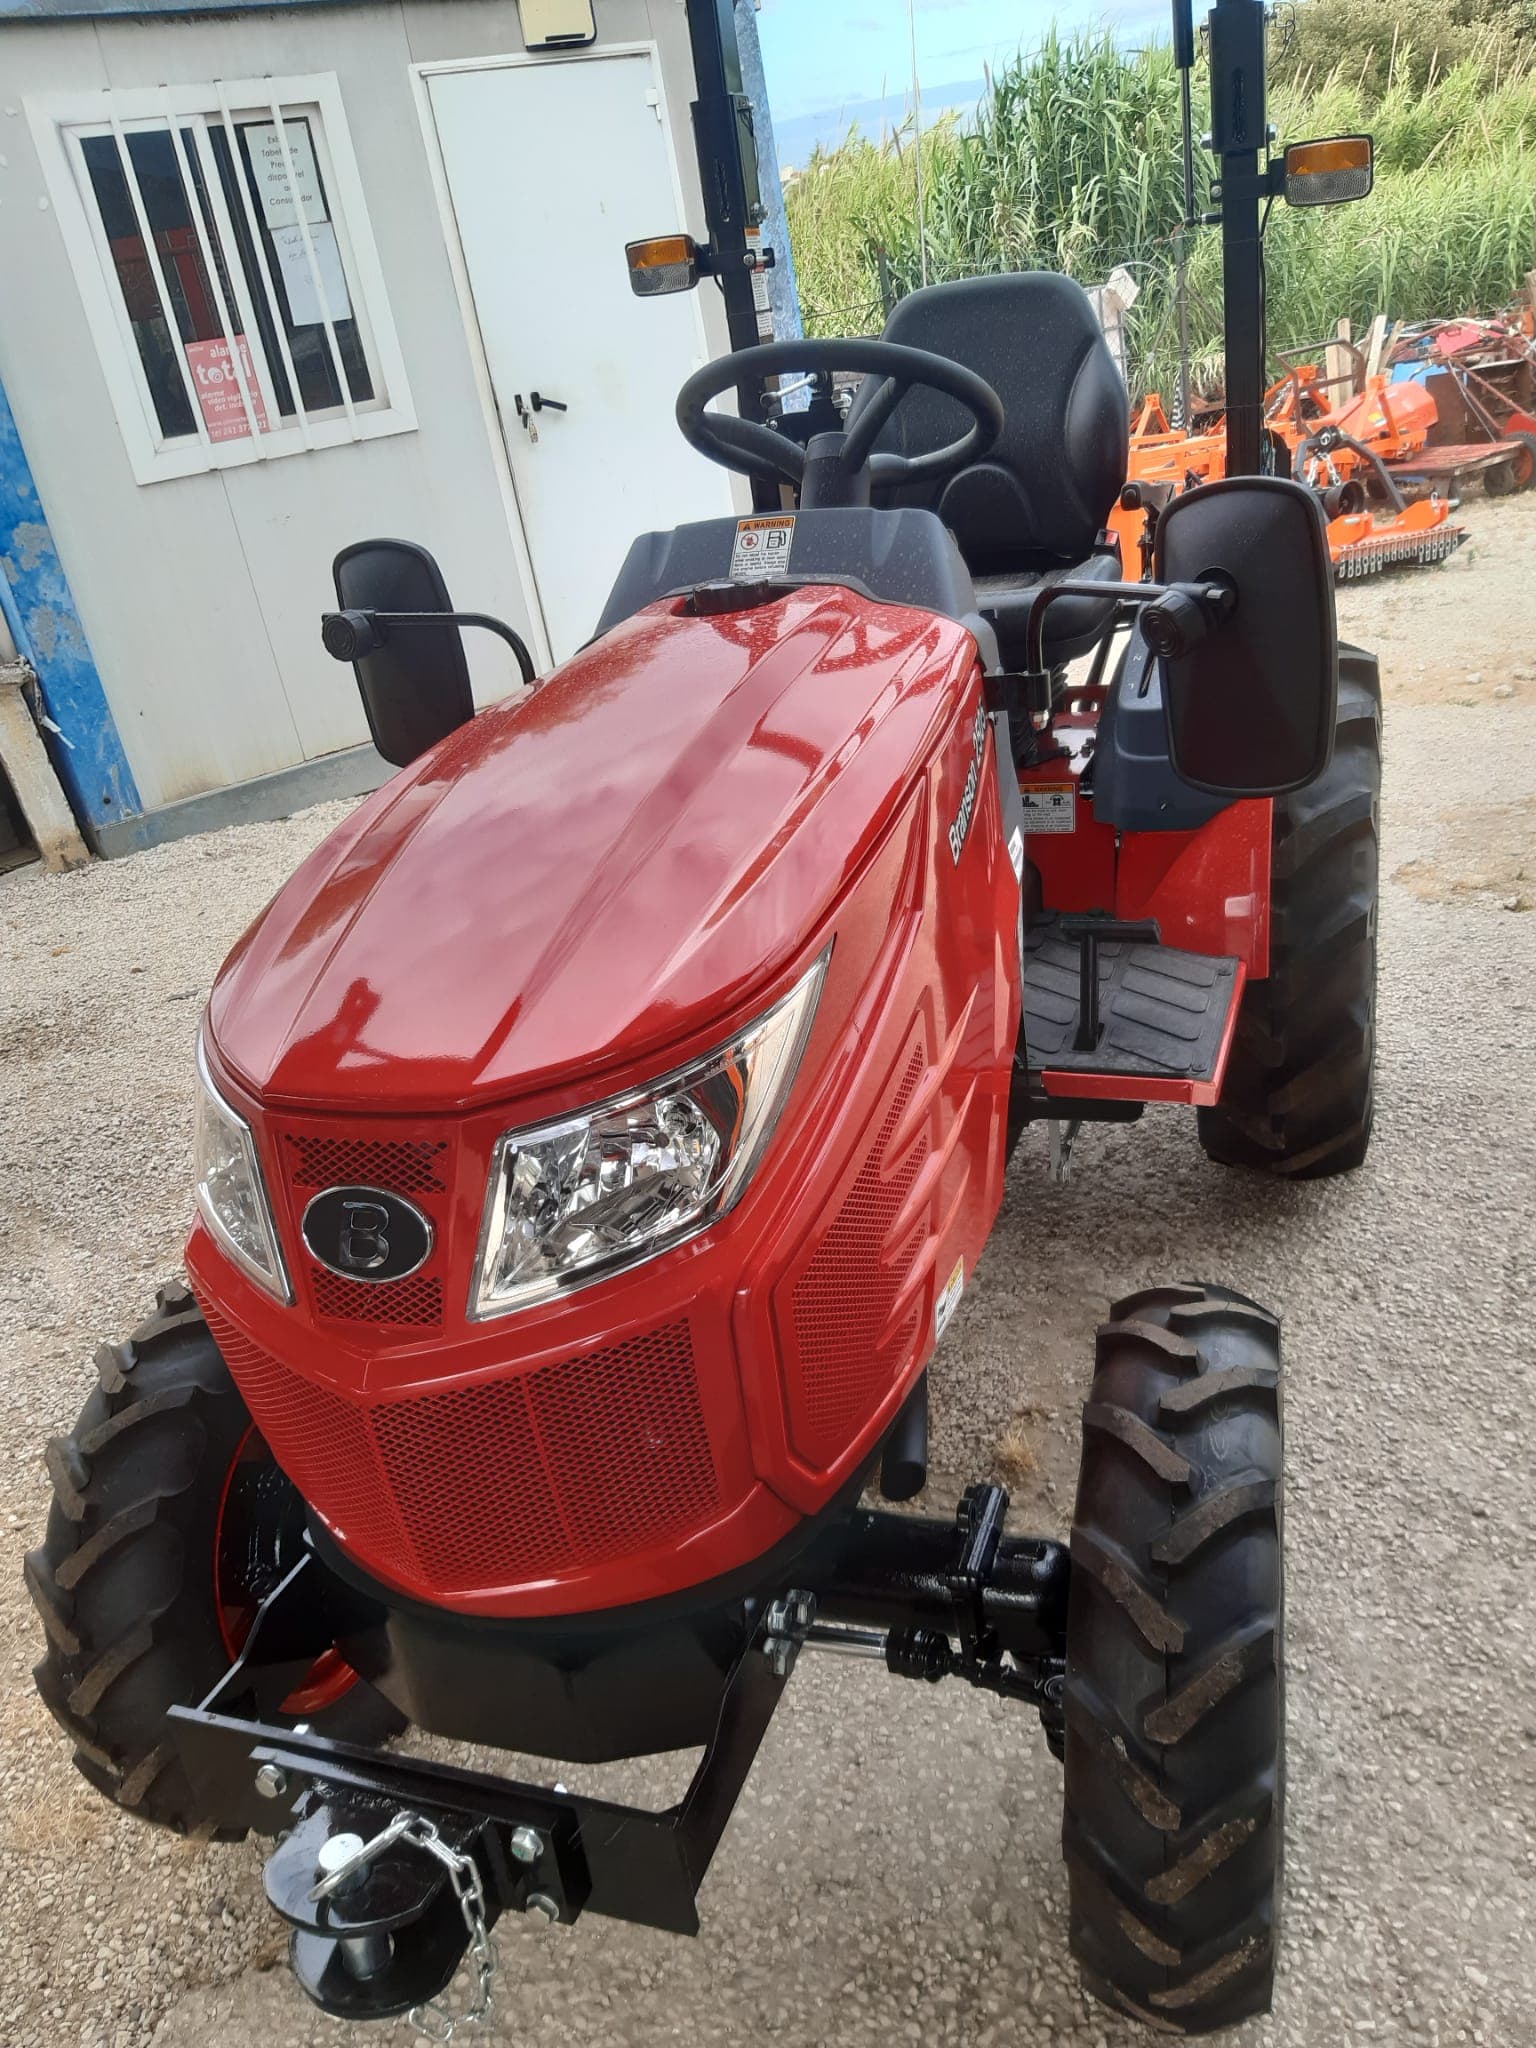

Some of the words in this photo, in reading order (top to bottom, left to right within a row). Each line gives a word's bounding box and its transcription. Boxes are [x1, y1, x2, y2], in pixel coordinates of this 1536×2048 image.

[261, 148, 282, 158] Tabel
[209, 343, 247, 359] alare
[196, 353, 252, 385] totl
[753, 519, 790, 529] WARNING
[948, 759, 978, 868] Branson
[340, 1201, 390, 1268] B
